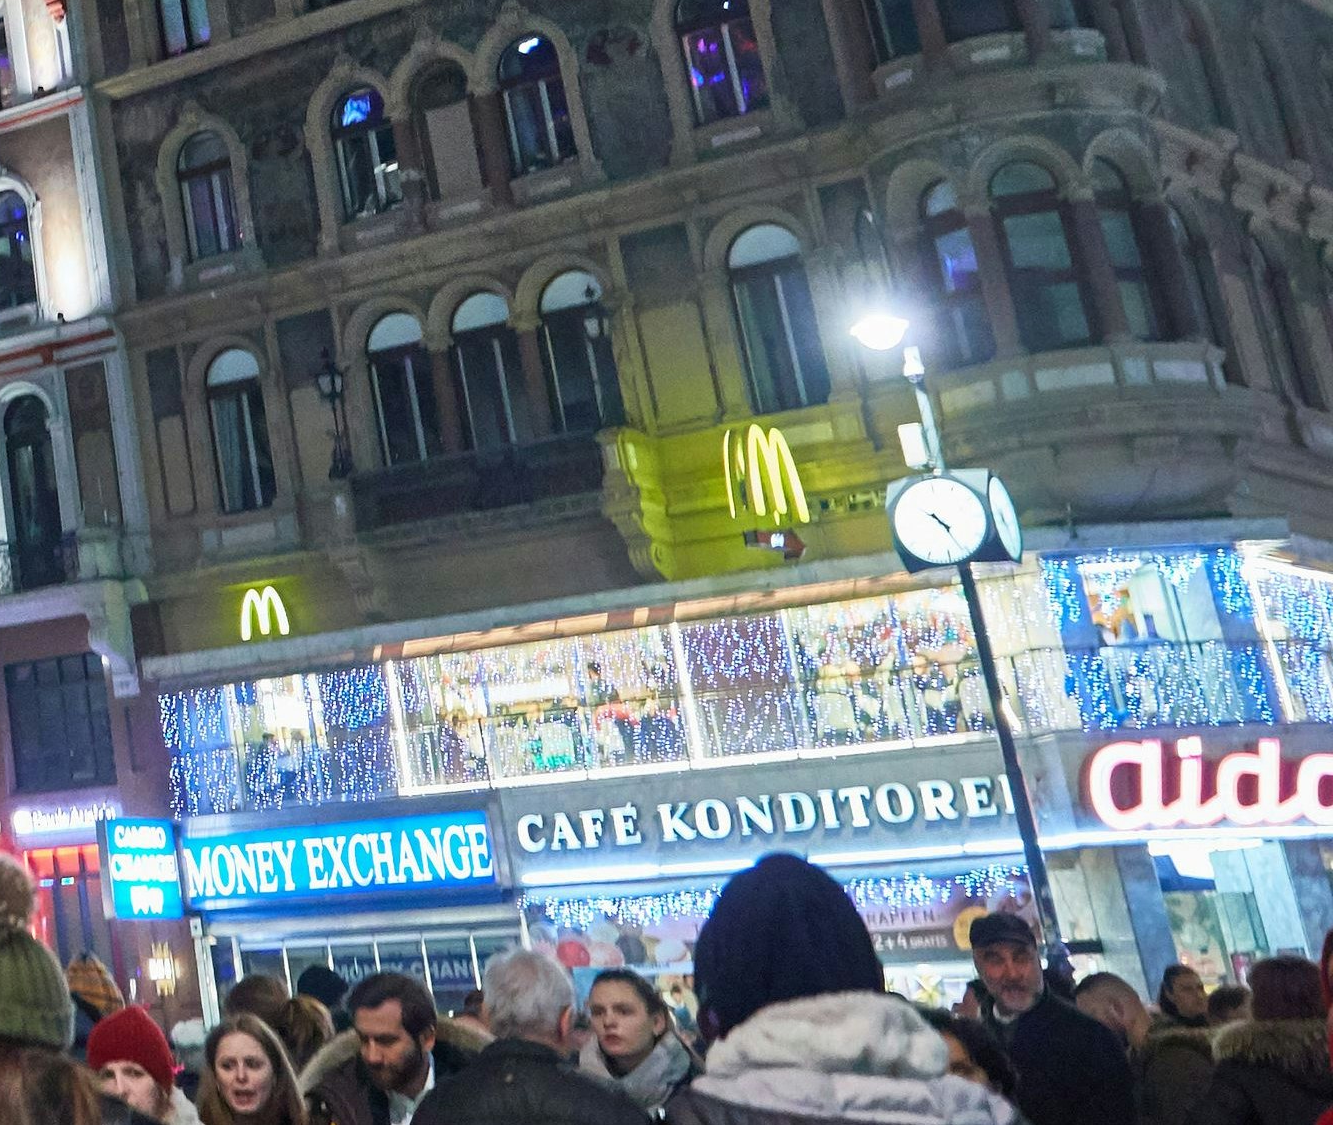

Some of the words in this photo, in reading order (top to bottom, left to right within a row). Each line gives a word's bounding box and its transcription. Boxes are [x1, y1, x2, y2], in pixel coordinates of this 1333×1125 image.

[517, 802, 642, 852] CAFÉ
[184, 840, 296, 898] MONEY
[303, 823, 492, 890] EXCHANGE
